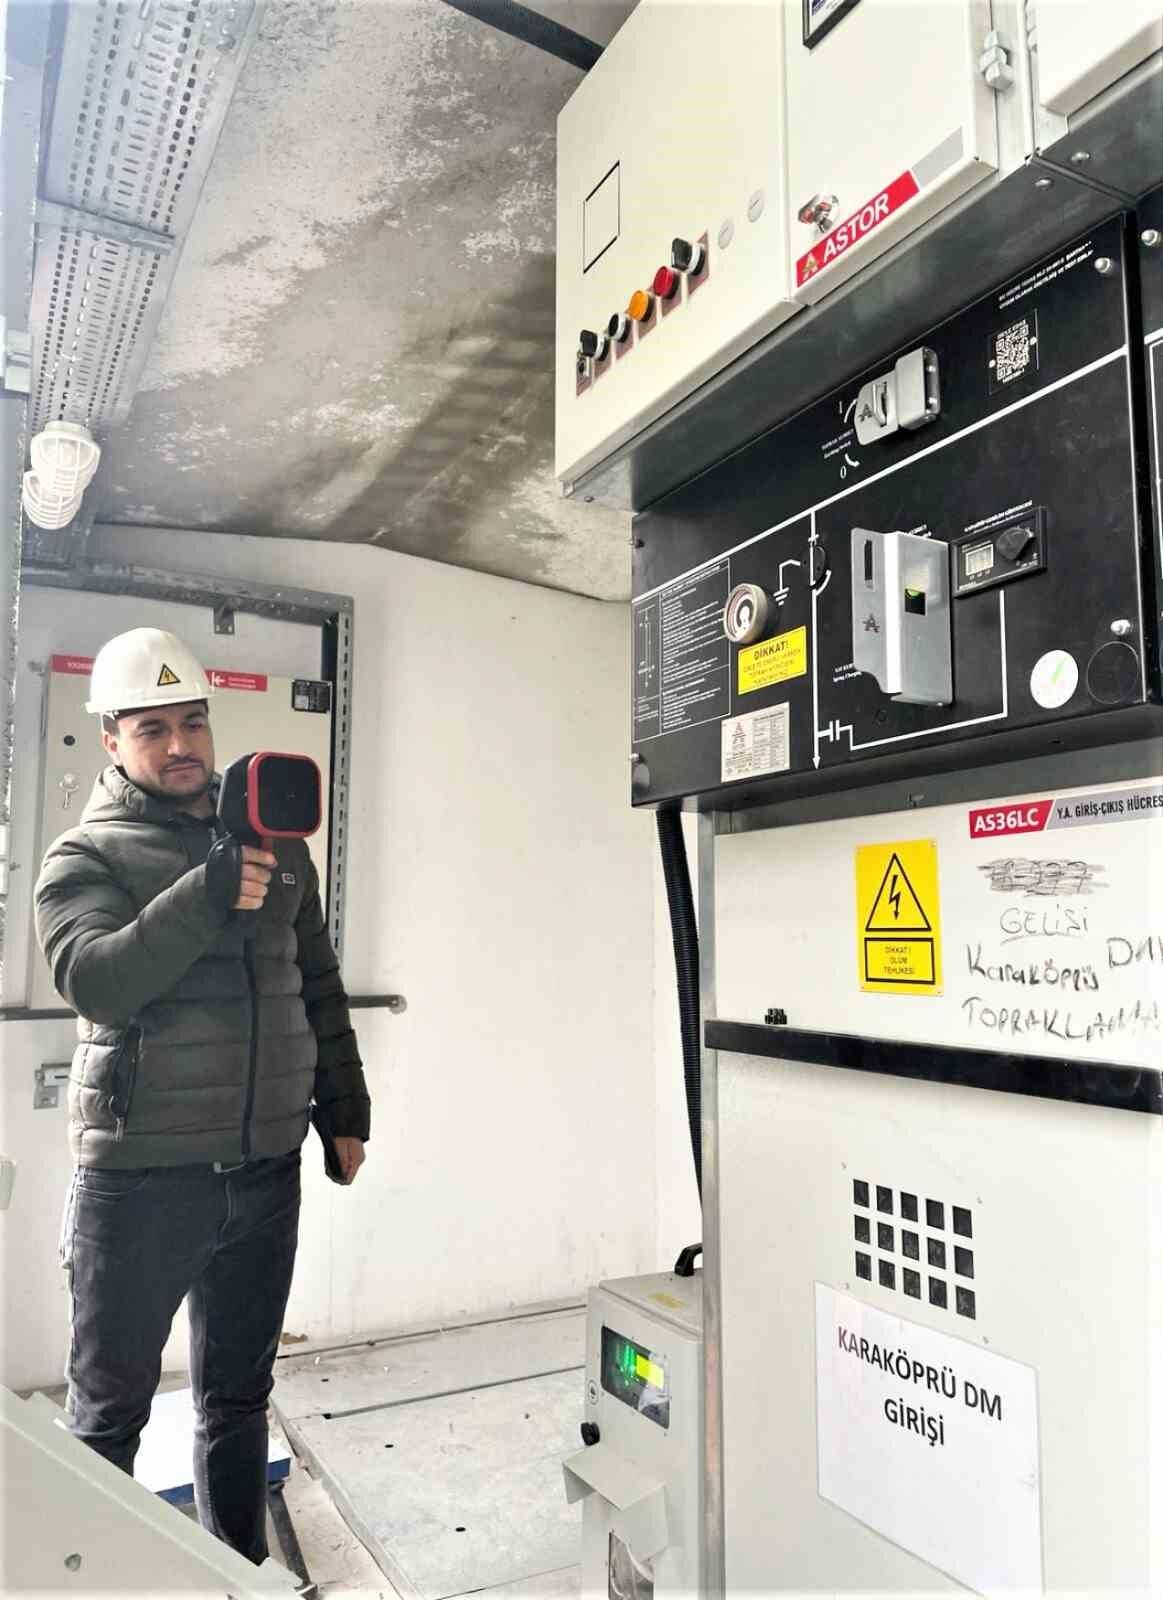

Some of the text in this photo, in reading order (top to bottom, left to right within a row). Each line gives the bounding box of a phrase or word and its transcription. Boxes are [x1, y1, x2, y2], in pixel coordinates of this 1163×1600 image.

[823, 192, 890, 263] ASTOR
[973, 807, 1040, 833] AS36LC
[838, 1325, 1002, 1421] KARAKÖPRÜ DM
[884, 1397, 945, 1447] GİRİŞİ
